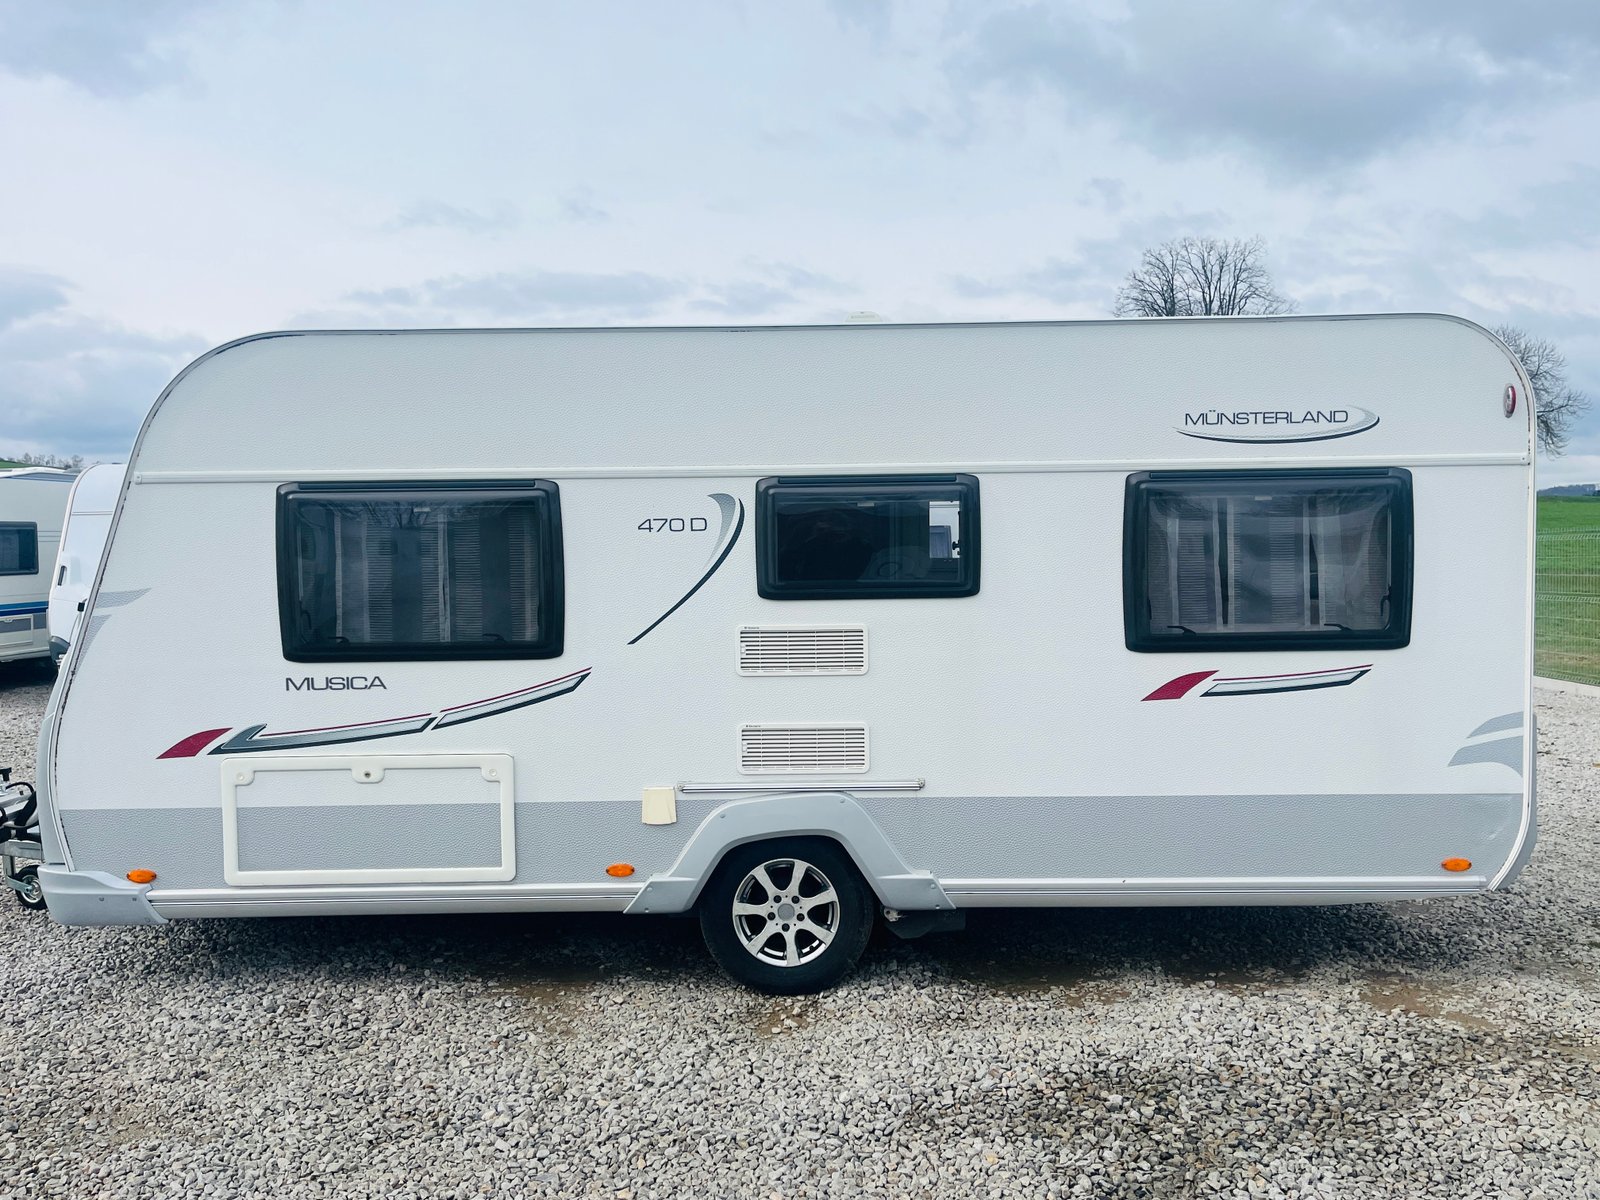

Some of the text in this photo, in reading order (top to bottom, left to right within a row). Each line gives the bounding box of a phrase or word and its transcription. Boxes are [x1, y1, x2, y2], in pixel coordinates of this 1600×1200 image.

[1184, 409, 1349, 426] MÜNSTERLAND
[637, 517, 708, 533] 470 D
[285, 675, 388, 692] MUSICA
